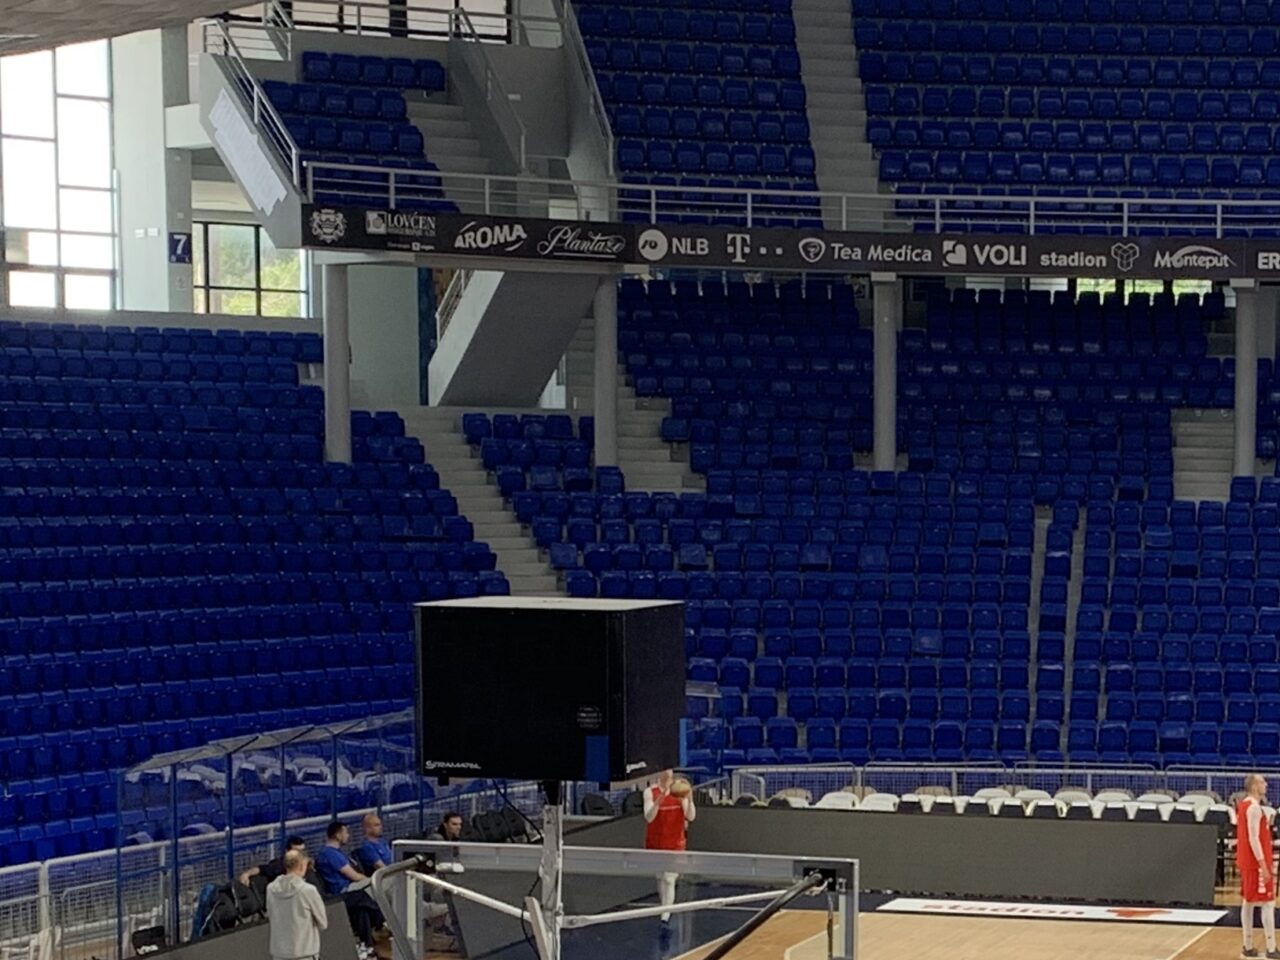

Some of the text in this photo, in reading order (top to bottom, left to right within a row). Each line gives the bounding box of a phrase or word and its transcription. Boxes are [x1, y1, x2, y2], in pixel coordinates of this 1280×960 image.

[387, 211, 437, 229] LOVĆEN
[173, 234, 188, 255] 7
[454, 222, 528, 249] AROMA
[671, 237, 710, 256] NLB
[831, 243, 933, 262] Tea Medica
[972, 243, 1027, 266] VOLI
[1040, 251, 1108, 267] stadion
[1154, 246, 1232, 269] Monteput
